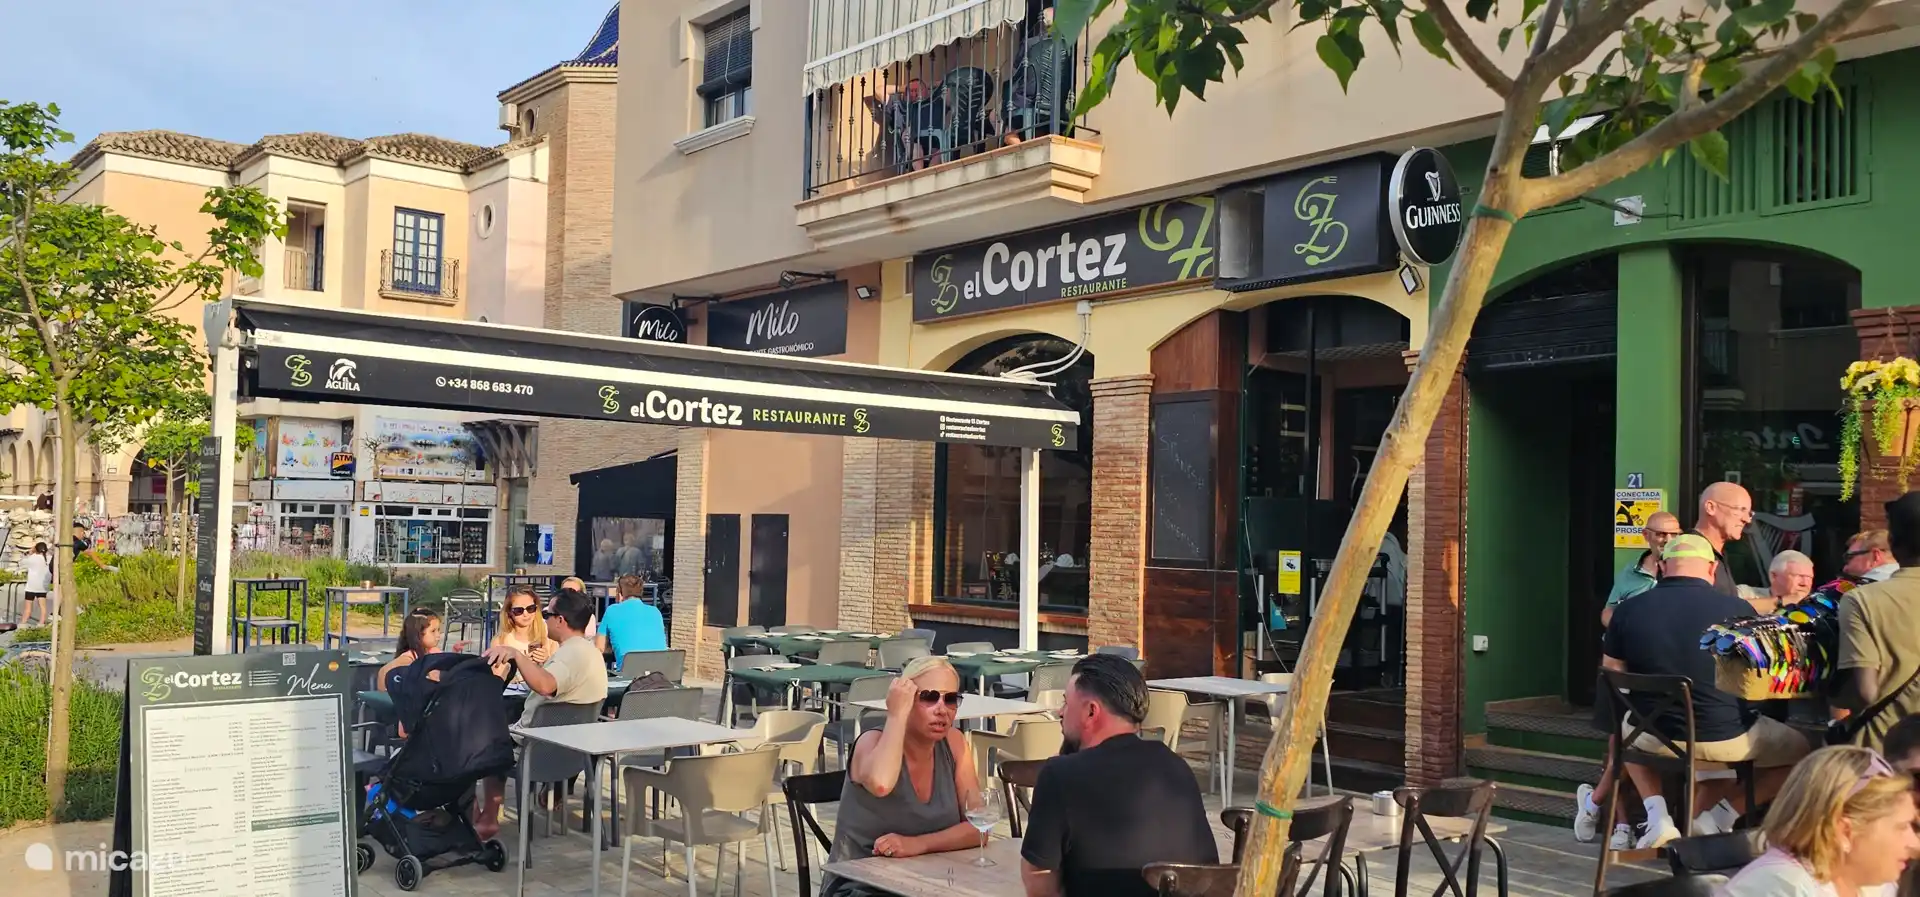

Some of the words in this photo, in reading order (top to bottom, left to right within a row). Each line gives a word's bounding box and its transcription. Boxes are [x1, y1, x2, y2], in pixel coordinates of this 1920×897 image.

[1405, 203, 1461, 229] GUINNESS
[963, 272, 982, 300] el
[982, 232, 1127, 296] Cortez
[1061, 278, 1127, 298] RESTAURANTE
[638, 319, 678, 342] Milo
[746, 299, 799, 345] Milo
[767, 342, 814, 355] GASTRONÓMICO
[447, 378, 468, 389] +34
[470, 379, 490, 391] 868
[492, 382, 512, 393] 683
[514, 384, 533, 396] 470
[630, 401, 645, 418] el
[646, 390, 743, 426] Cortez
[753, 408, 846, 426] RESTAURANTE
[334, 454, 353, 462] ATM
[1628, 473, 1643, 488] 21
[174, 670, 242, 688] Cortez
[287, 663, 333, 696] Menu
